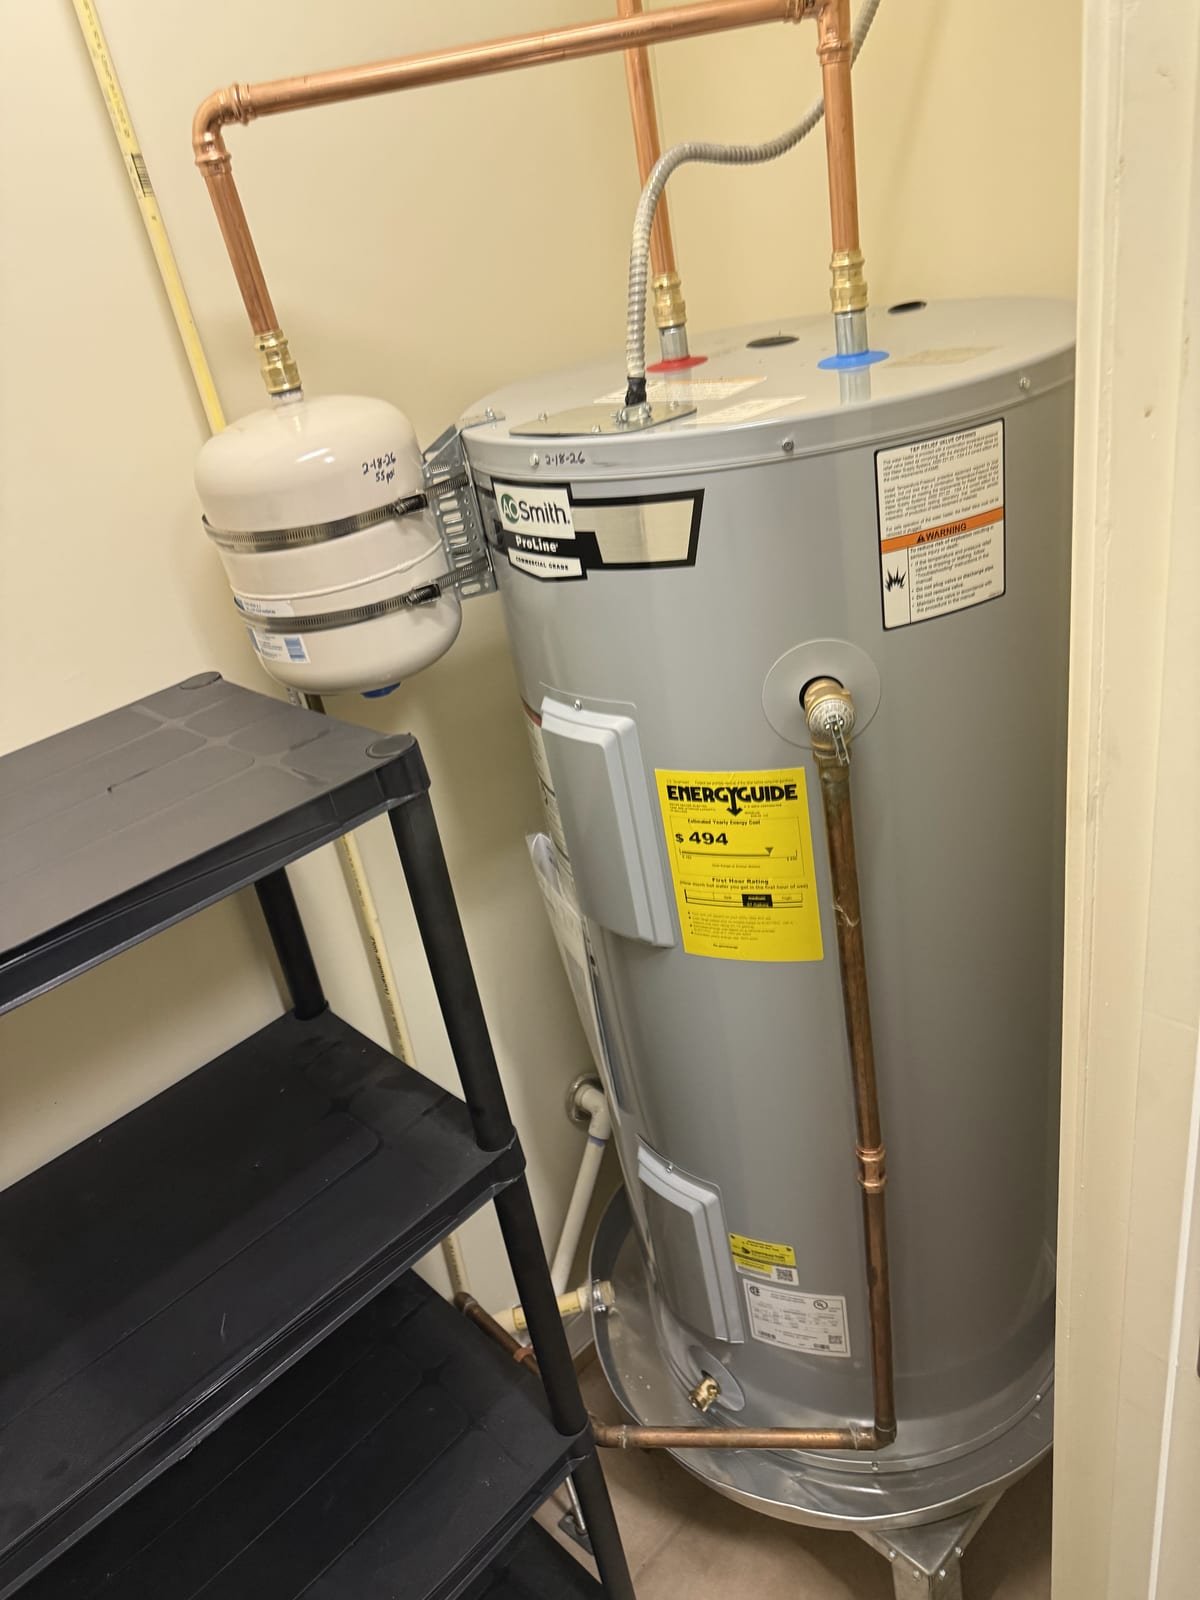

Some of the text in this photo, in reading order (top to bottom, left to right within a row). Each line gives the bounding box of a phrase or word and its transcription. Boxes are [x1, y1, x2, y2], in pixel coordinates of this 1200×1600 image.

[362, 452, 396, 475] 2-18-26
[545, 451, 585, 466] 2-18-26
[926, 523, 966, 541] WARNING
[666, 784, 798, 804] ENERGYGUIDE
[689, 832, 728, 845] 494
